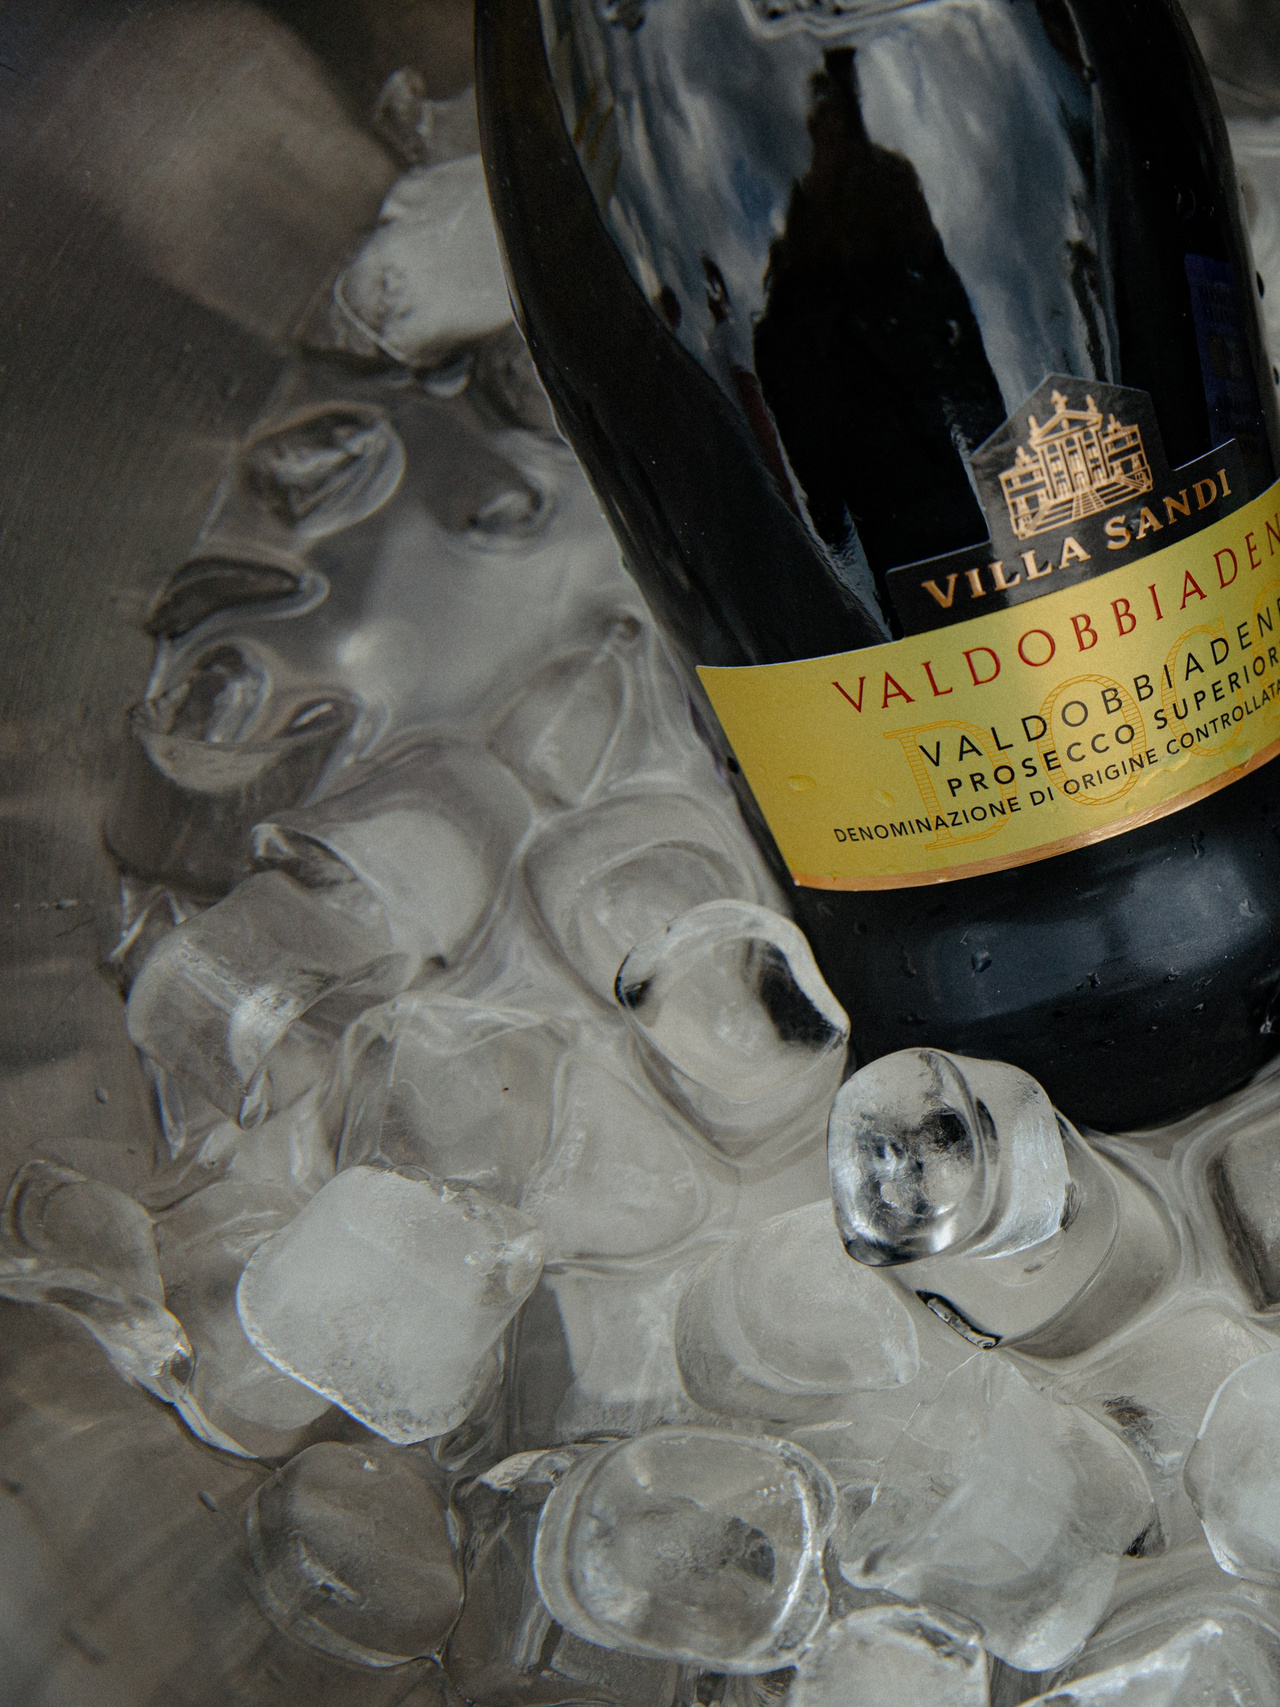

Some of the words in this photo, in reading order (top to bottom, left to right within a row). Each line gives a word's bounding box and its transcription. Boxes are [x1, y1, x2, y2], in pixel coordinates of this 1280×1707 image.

[922, 536, 1092, 609] VILLA
[1106, 468, 1232, 550] SANDI
[833, 796, 1021, 842] DENOMINAZIONE
[1029, 786, 1055, 806] DI
[1063, 747, 1159, 795] ORIGINE
[947, 724, 1135, 797] PROSECCO
